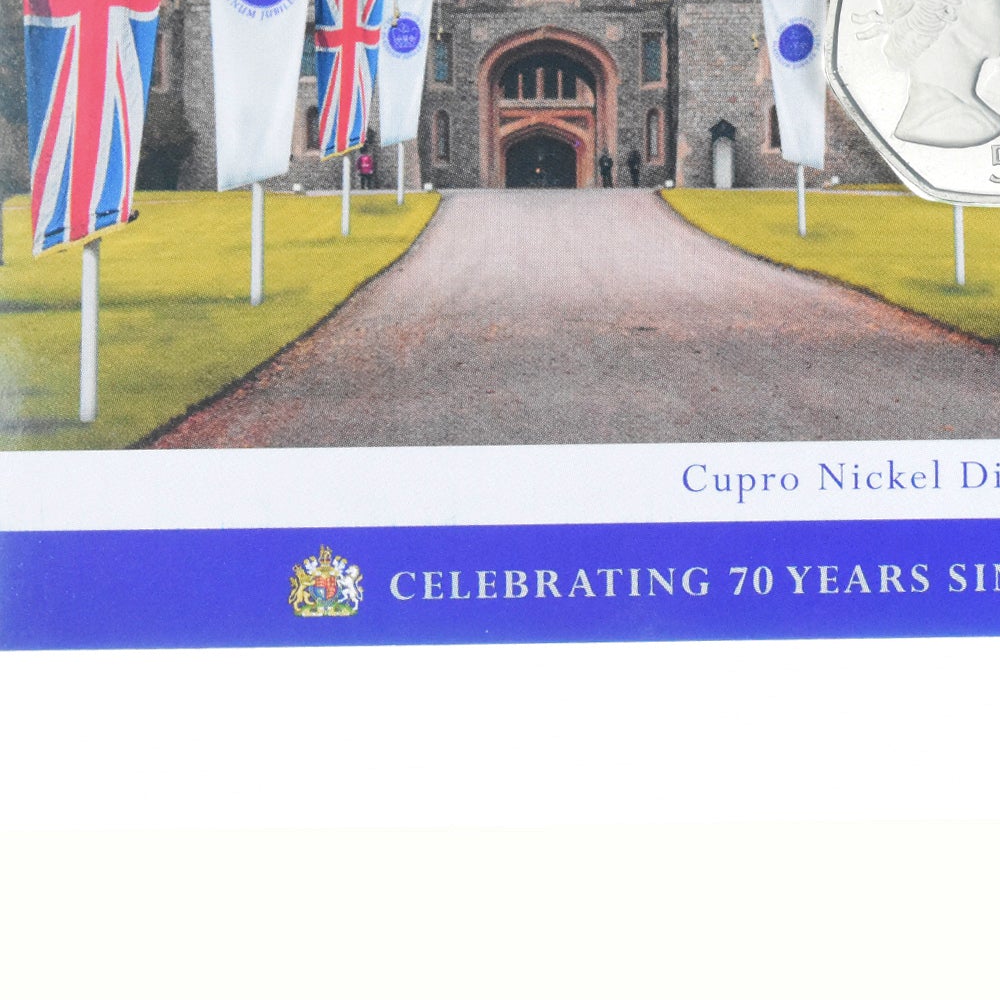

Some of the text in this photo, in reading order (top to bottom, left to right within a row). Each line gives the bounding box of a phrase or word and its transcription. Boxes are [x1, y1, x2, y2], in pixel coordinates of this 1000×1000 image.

[683, 463, 799, 505] Cupro
[818, 460, 940, 491] Nickel
[389, 565, 709, 601] CELEBRATING
[729, 565, 774, 596] 70
[785, 563, 930, 594] YEARS
